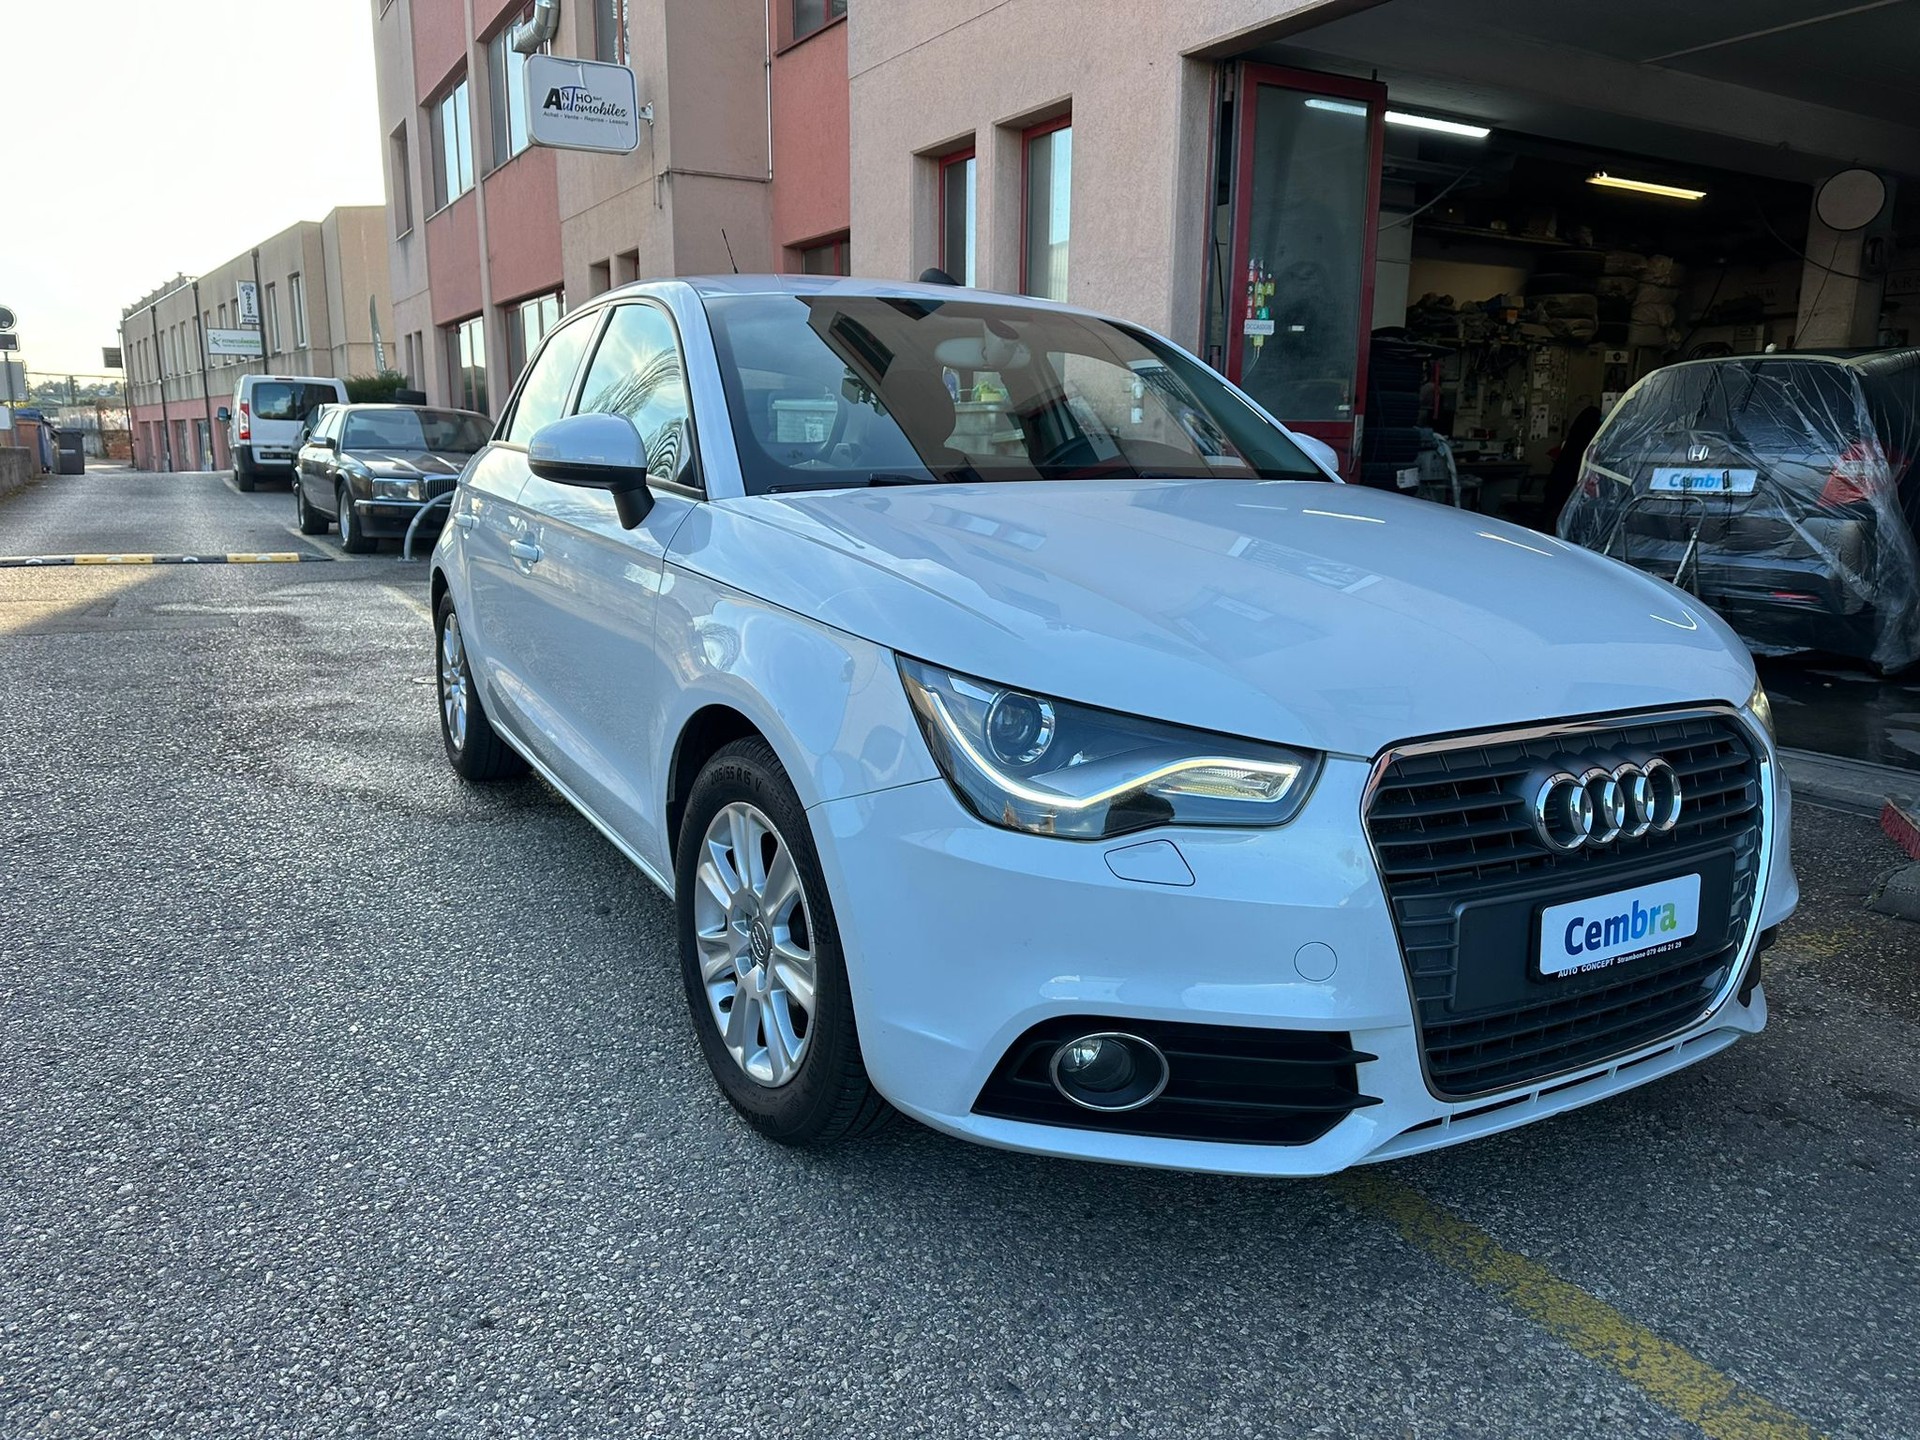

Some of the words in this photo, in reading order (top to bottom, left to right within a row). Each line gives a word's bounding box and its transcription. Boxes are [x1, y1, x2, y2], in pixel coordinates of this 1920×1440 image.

[584, 115, 604, 123] Reprise
[609, 118, 629, 126] Leasing
[1564, 900, 1677, 956] Cembra
[1558, 966, 1578, 978] AUTO
[1581, 958, 1615, 973] CONCEPT
[1646, 948, 1657, 957] 079
